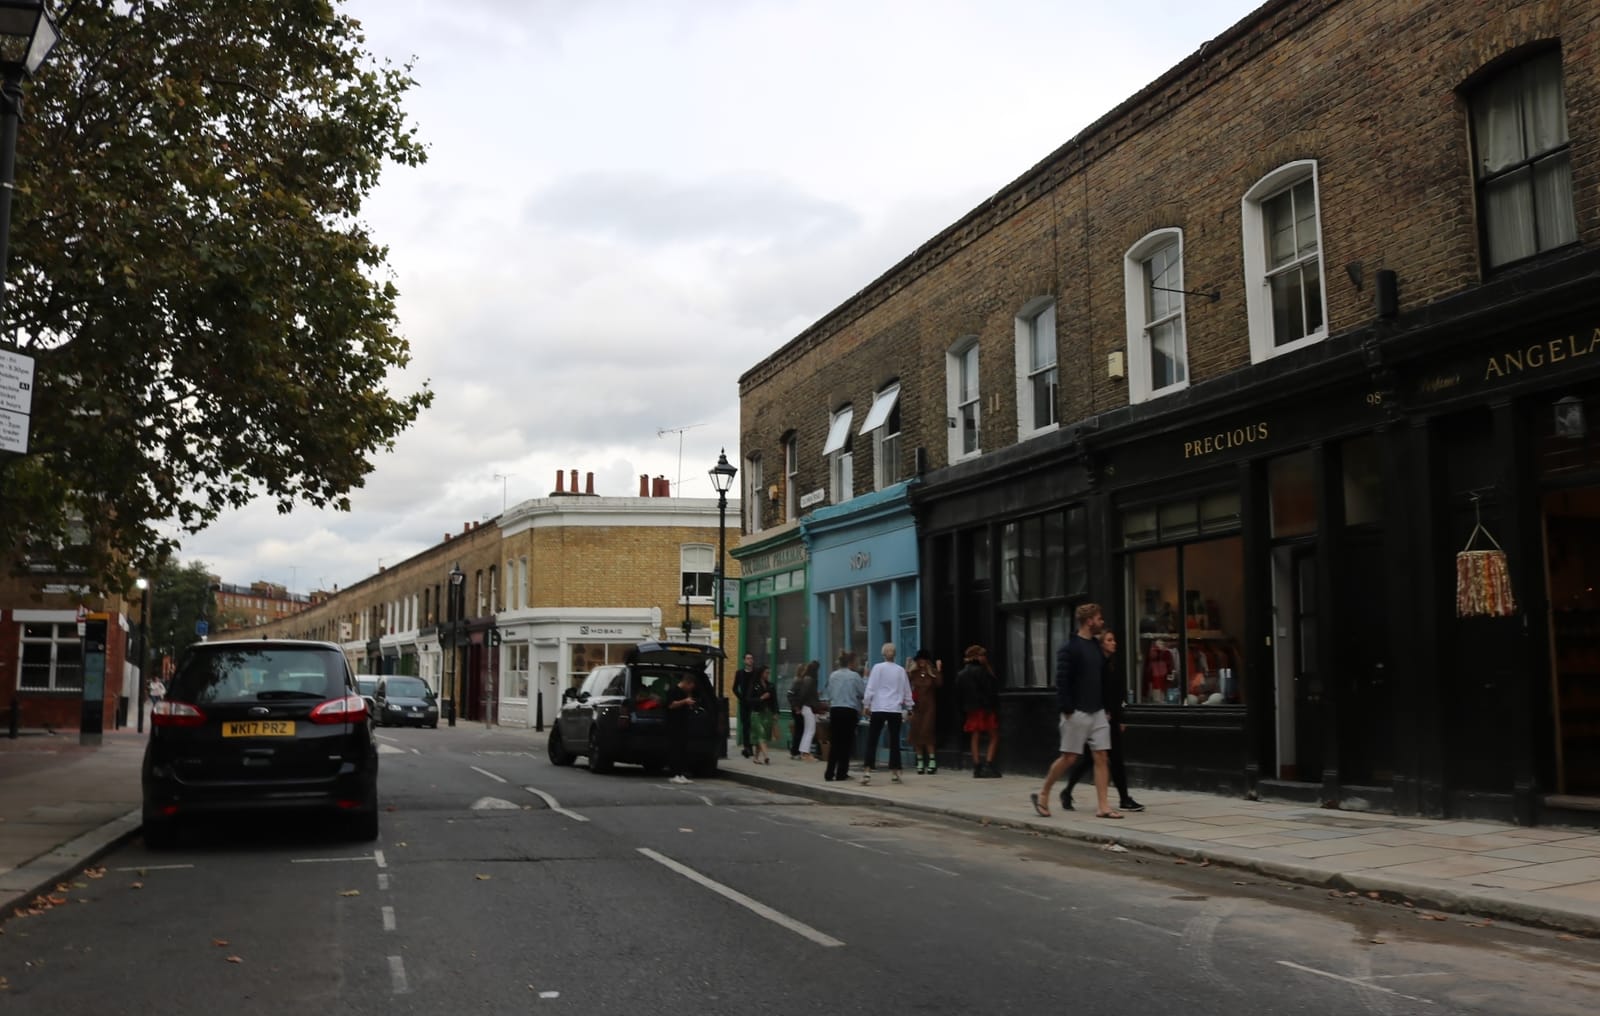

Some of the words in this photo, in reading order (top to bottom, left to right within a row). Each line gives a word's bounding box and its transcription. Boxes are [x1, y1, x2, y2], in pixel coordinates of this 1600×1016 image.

[1485, 328, 1600, 380] ANGELA
[1184, 422, 1268, 458] PRECIOUS
[230, 722, 258, 734] WK17
[262, 721, 287, 734] PRZ
